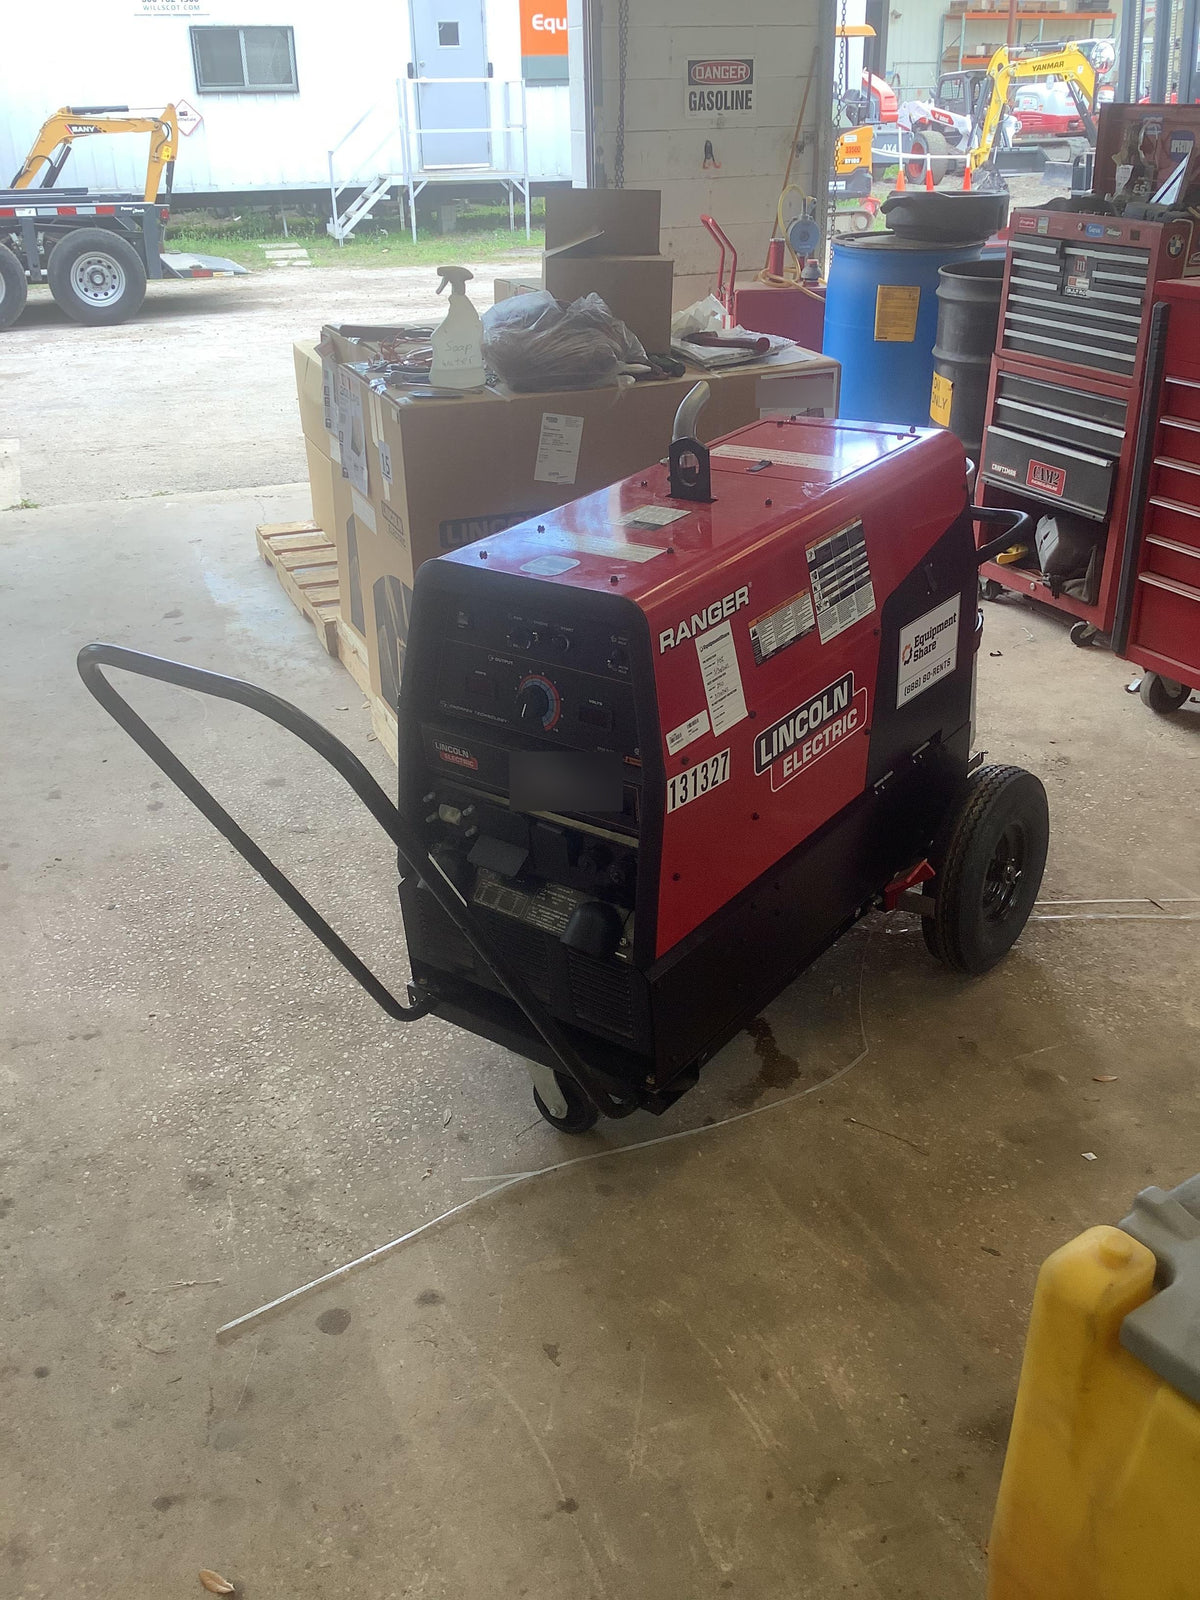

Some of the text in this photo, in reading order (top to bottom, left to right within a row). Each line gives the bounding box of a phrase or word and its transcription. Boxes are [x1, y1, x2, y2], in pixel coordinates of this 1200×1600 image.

[695, 65, 746, 79] DANGER
[1032, 61, 1065, 71] YANMAR
[688, 89, 753, 111] GASOLINE
[659, 585, 750, 654] RANGER
[914, 612, 957, 648] Equipment
[913, 640, 937, 663] Share
[760, 680, 848, 767] LINCOLN
[434, 741, 469, 759] LINCOLN
[783, 708, 858, 778] ELECTRIC
[669, 750, 729, 810] 131327
